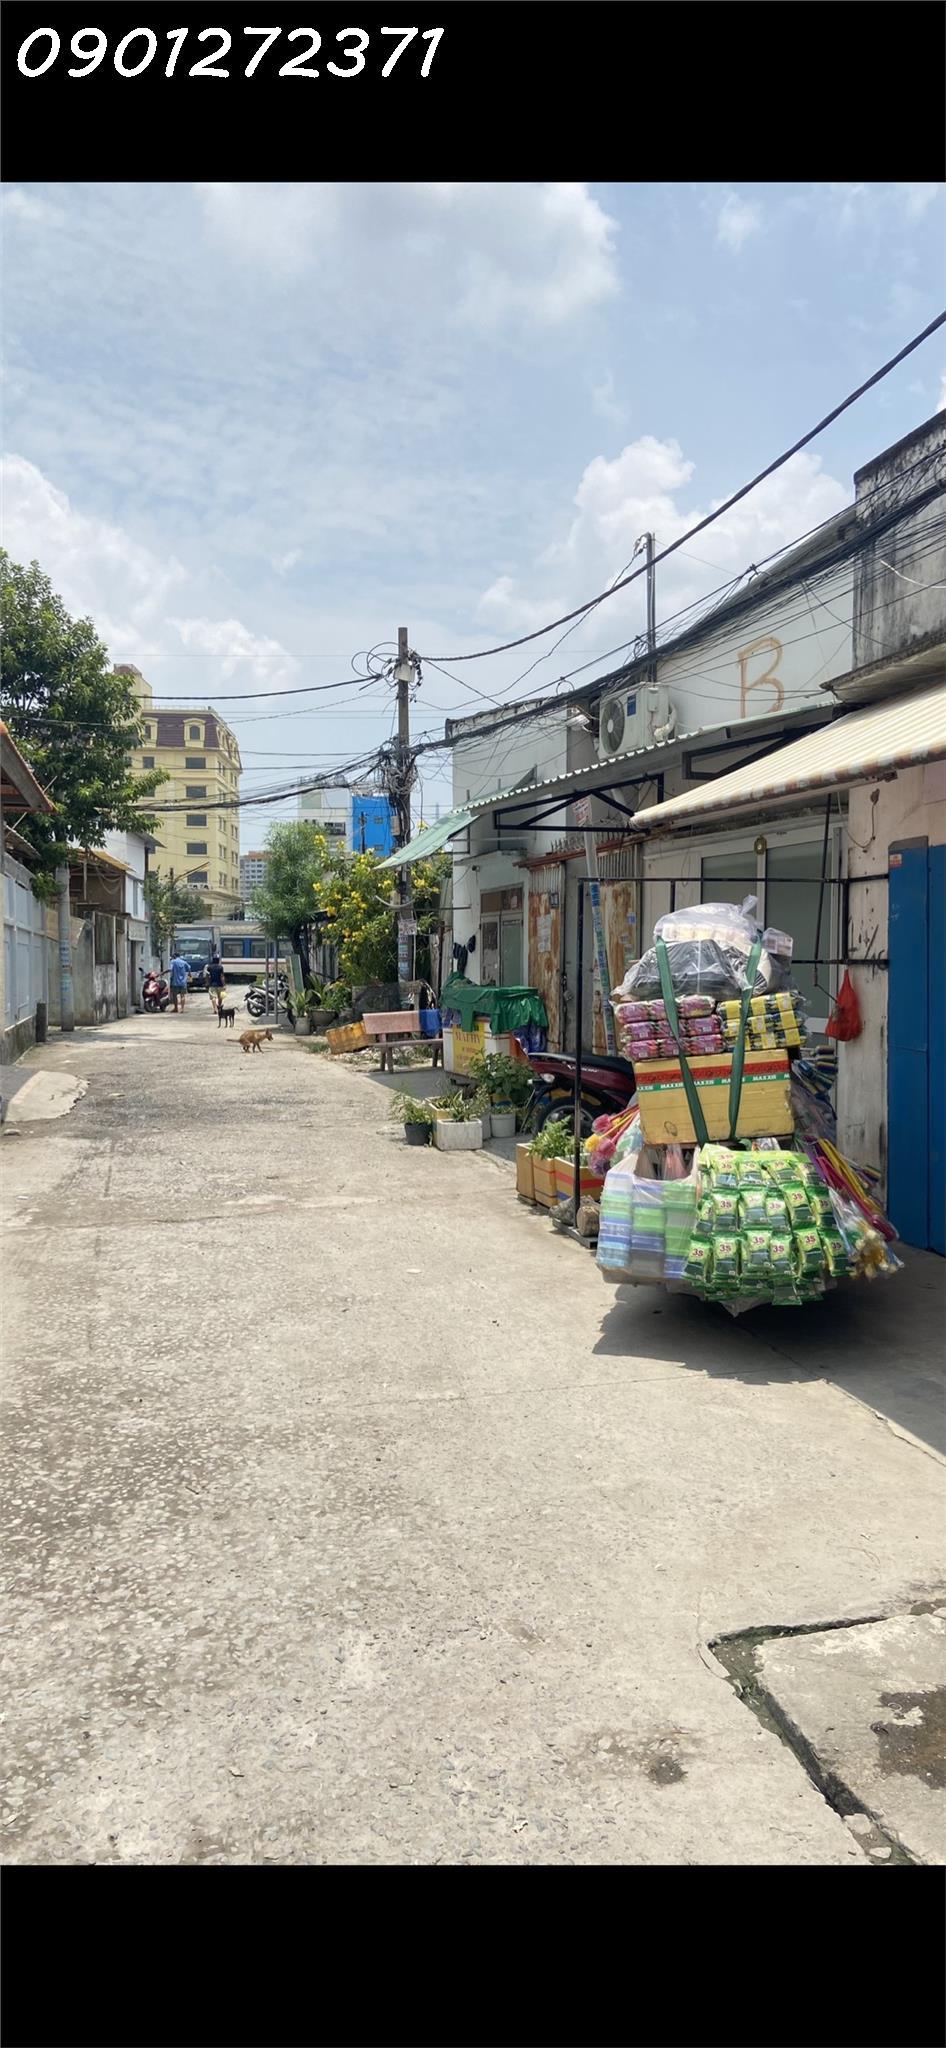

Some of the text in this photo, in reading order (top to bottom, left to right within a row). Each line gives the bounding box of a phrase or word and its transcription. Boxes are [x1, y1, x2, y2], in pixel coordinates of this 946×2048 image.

[737, 636, 784, 718] B
[792, 1192, 803, 1200] 3S
[720, 1200, 732, 1208] 3S
[753, 1236, 765, 1245] 3S
[805, 1235, 816, 1244] 3S
[693, 1248, 704, 1257] 3S
[720, 1244, 731, 1252] 3S
[773, 1245, 785, 1254] 3S
